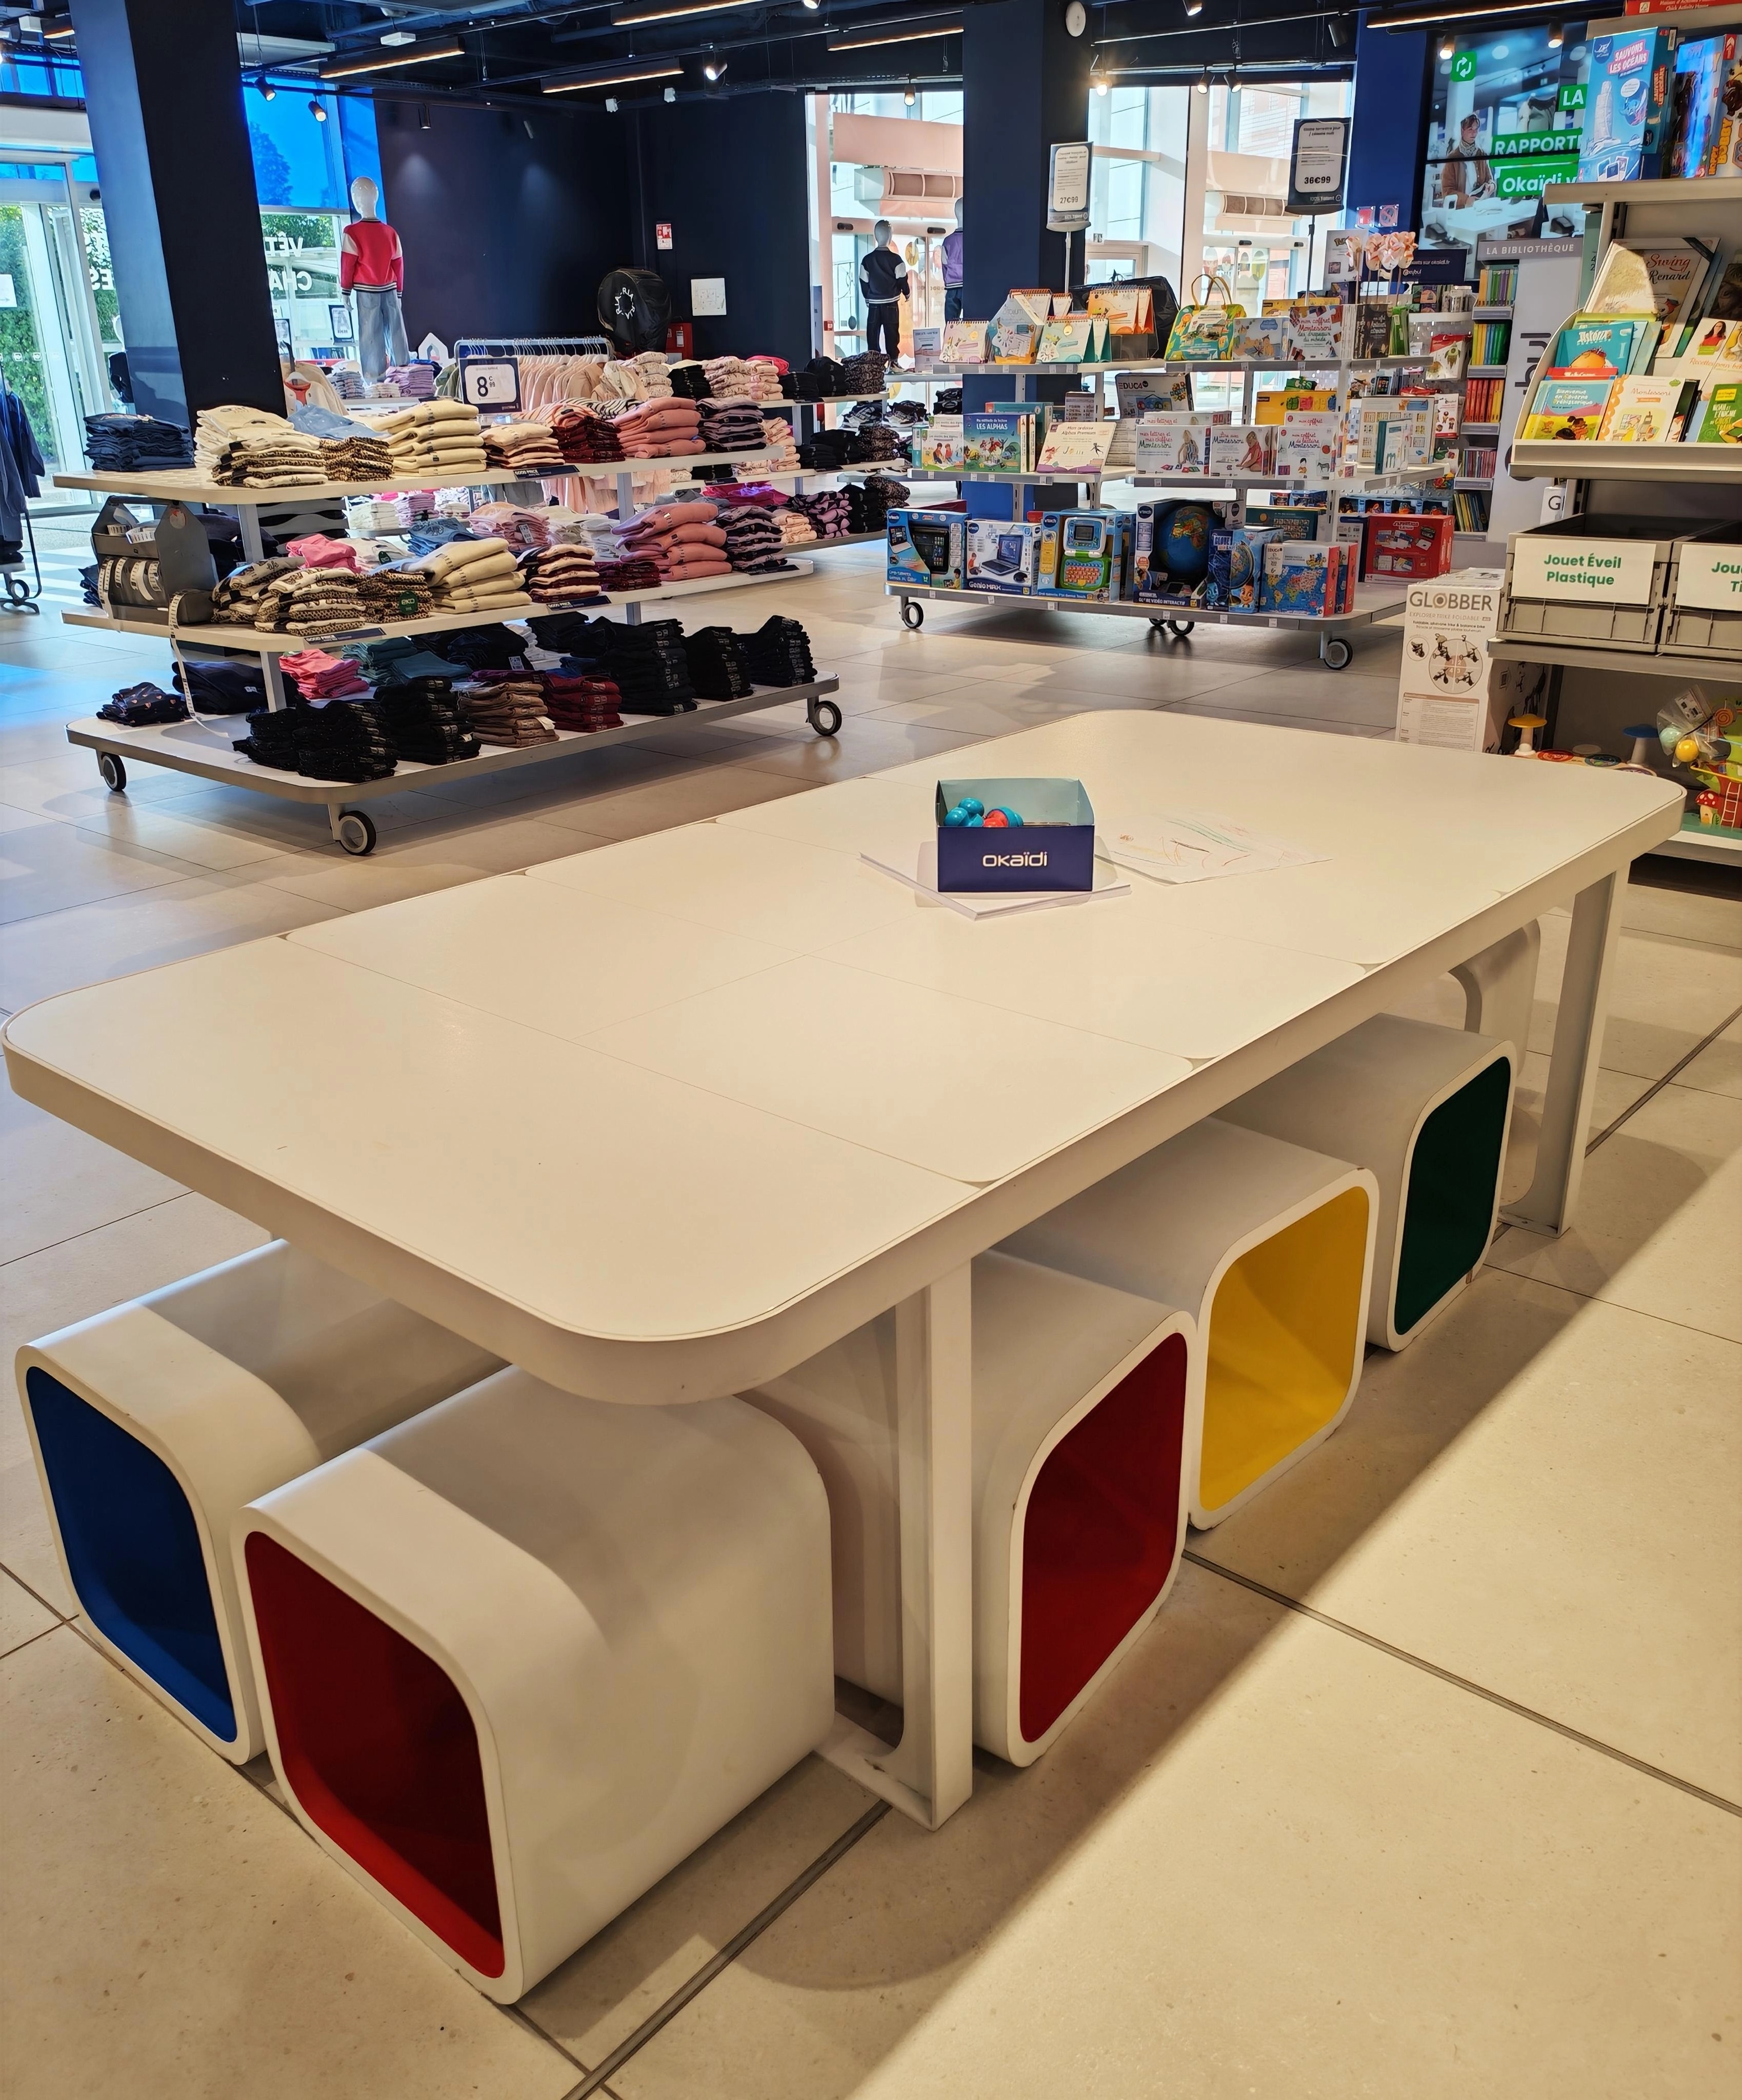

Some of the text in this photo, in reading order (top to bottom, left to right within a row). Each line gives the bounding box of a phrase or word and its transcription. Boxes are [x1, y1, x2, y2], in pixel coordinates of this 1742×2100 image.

[1615, 42, 1644, 61] SAUVONS
[1609, 62, 1622, 74] LES
[1622, 52, 1647, 70] OCÉANS
[1563, 89, 1584, 106] LA
[1495, 134, 1580, 155] RAPPORT
[1501, 243, 1574, 254] BIBLIOTHÈQUE
[1647, 253, 1691, 272] Swing
[1649, 270, 1691, 285] Renard
[477, 376, 488, 397] 8
[1631, 388, 1671, 396] Montessori
[1138, 440, 1172, 449] Montessori
[1212, 436, 1245, 444] Montessori
[1288, 441, 1320, 449] Montessori
[1544, 553, 1621, 569] Jouet Éveil
[1711, 562, 1742, 574] Jou
[1547, 571, 1614, 588] Plastique
[1410, 591, 1493, 611] GLOBBER
[983, 852, 1048, 867] okaïdi
